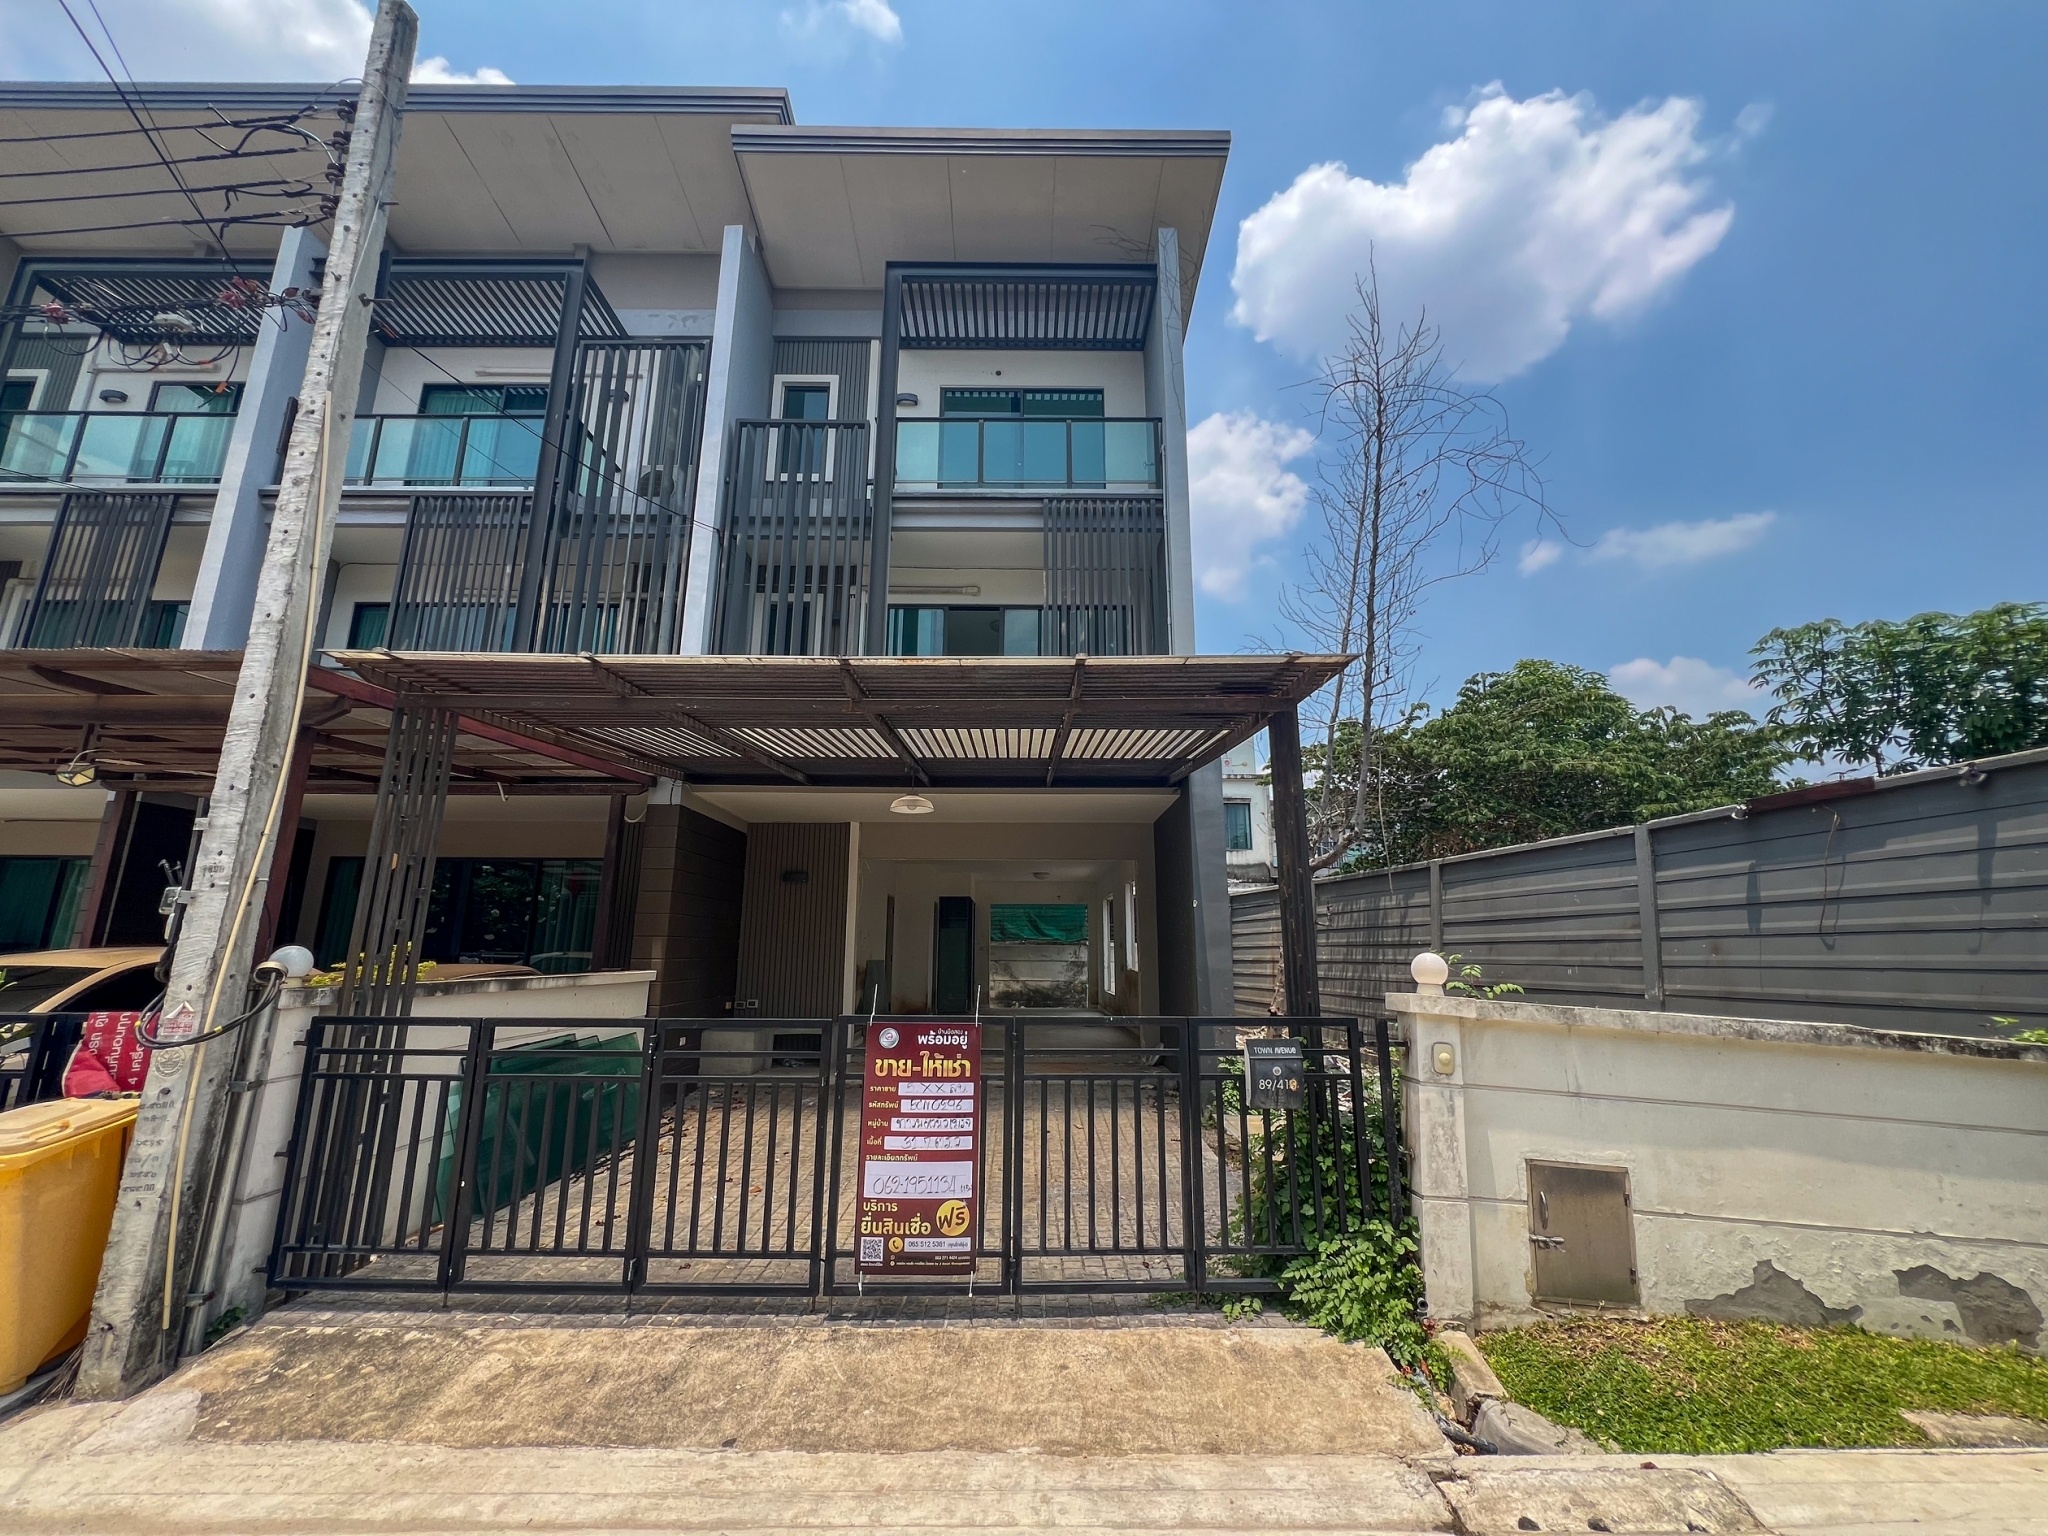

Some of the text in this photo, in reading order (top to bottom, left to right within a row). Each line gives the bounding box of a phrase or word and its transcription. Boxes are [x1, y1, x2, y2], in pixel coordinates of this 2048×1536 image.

[918, 1030, 968, 1050] พร้อมอยู่
[875, 1050, 971, 1078] ขาย-ให้เช่า
[869, 1085, 897, 1093] ราคาขาย
[868, 1100, 899, 1109] รหัสทรัพย์
[867, 1117, 889, 1129] หมู่บ้าน
[866, 1135, 882, 1146] เนื้อที่
[865, 1153, 918, 1161] รายละเอียดทรัพย์
[863, 1199, 898, 1212] บริการ
[860, 1212, 932, 1235] ยื่นสินเชื่อ
[938, 1206, 966, 1230] ฟรี
